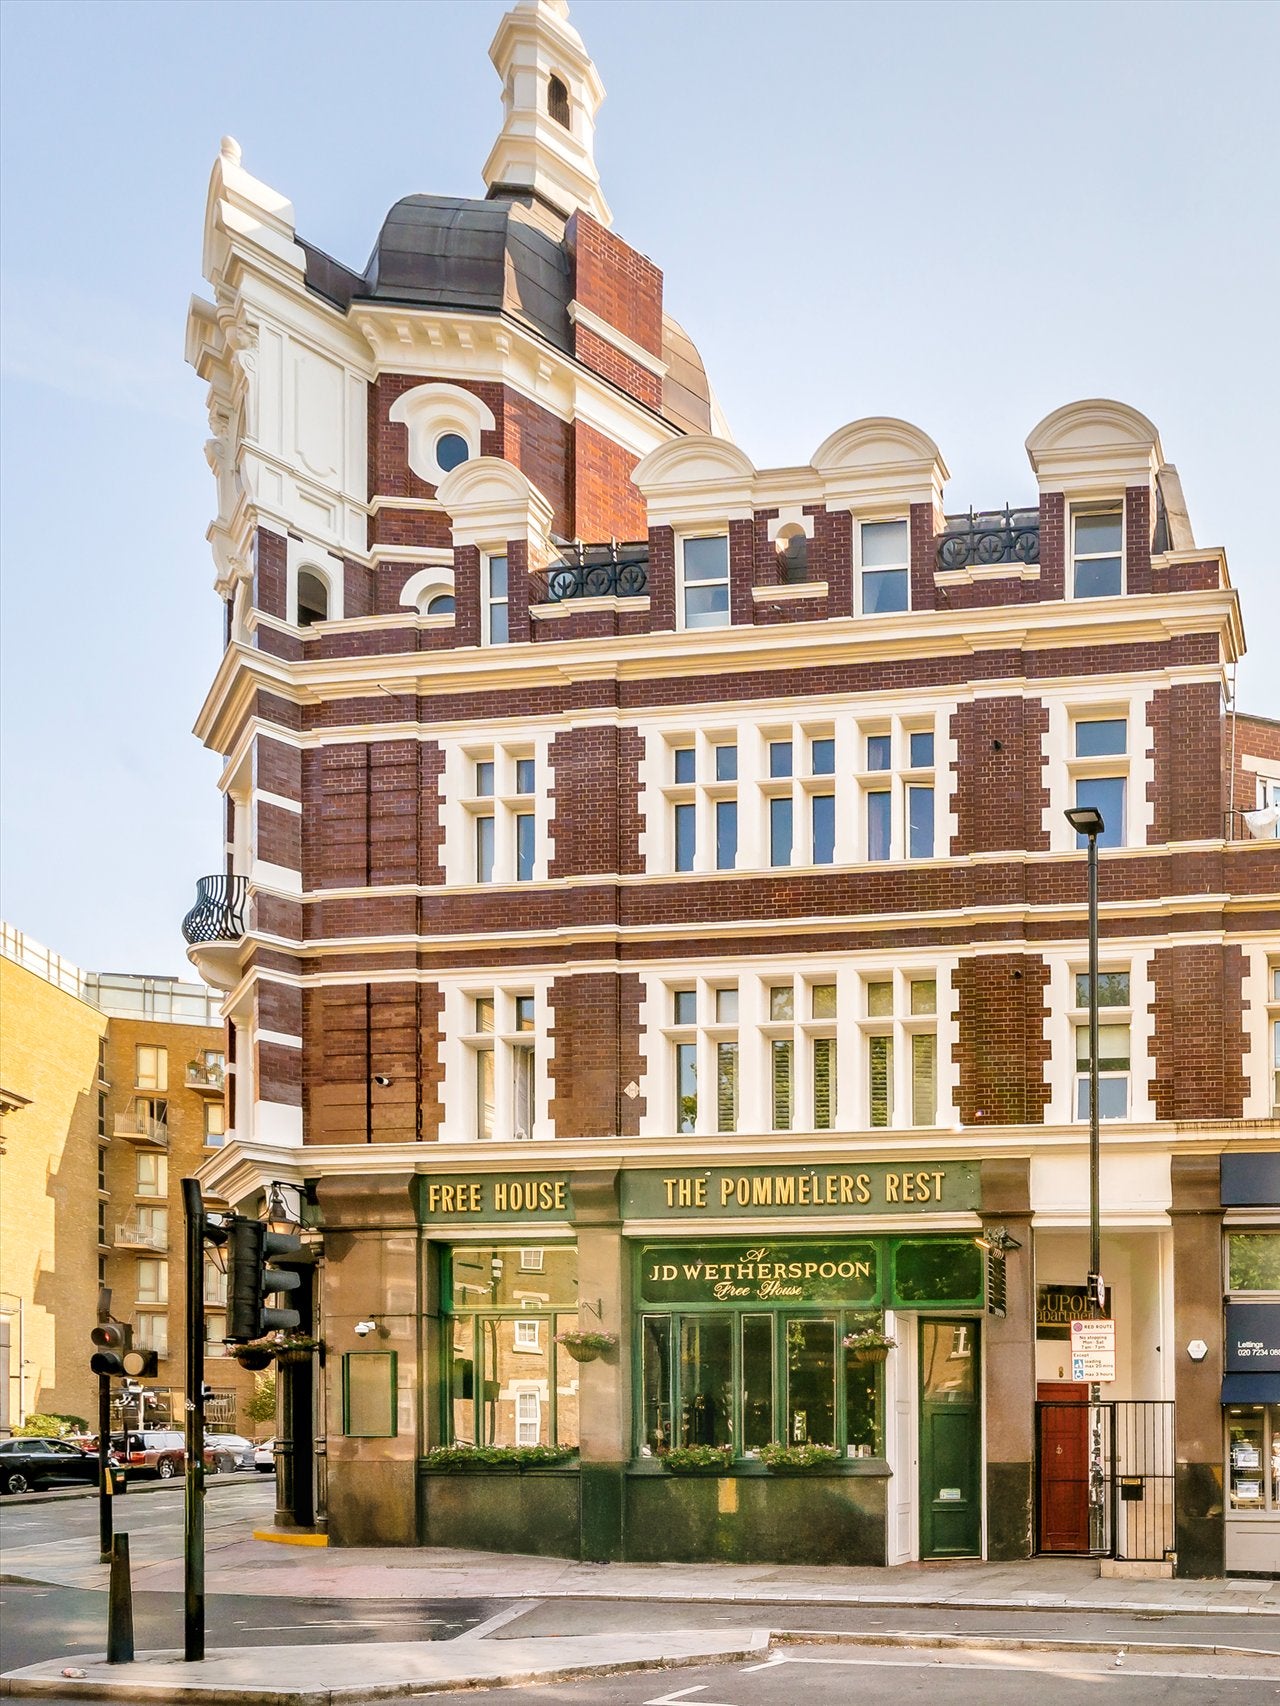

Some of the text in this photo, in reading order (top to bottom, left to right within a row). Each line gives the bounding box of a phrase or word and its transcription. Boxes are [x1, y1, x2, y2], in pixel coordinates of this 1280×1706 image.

[429, 1181, 566, 1212] FREE HOUSE
[663, 1172, 945, 1207] THE POMMELERS REST
[739, 1247, 769, 1262] A
[649, 1262, 871, 1281] JD WETHERSPOON
[713, 1280, 802, 1300] Free House
[1037, 1293, 1105, 1313] CUPOL
[1237, 1341, 1264, 1350] Lettings
[1237, 1348, 1251, 1356] 020
[1251, 1348, 1269, 1356] 7234
